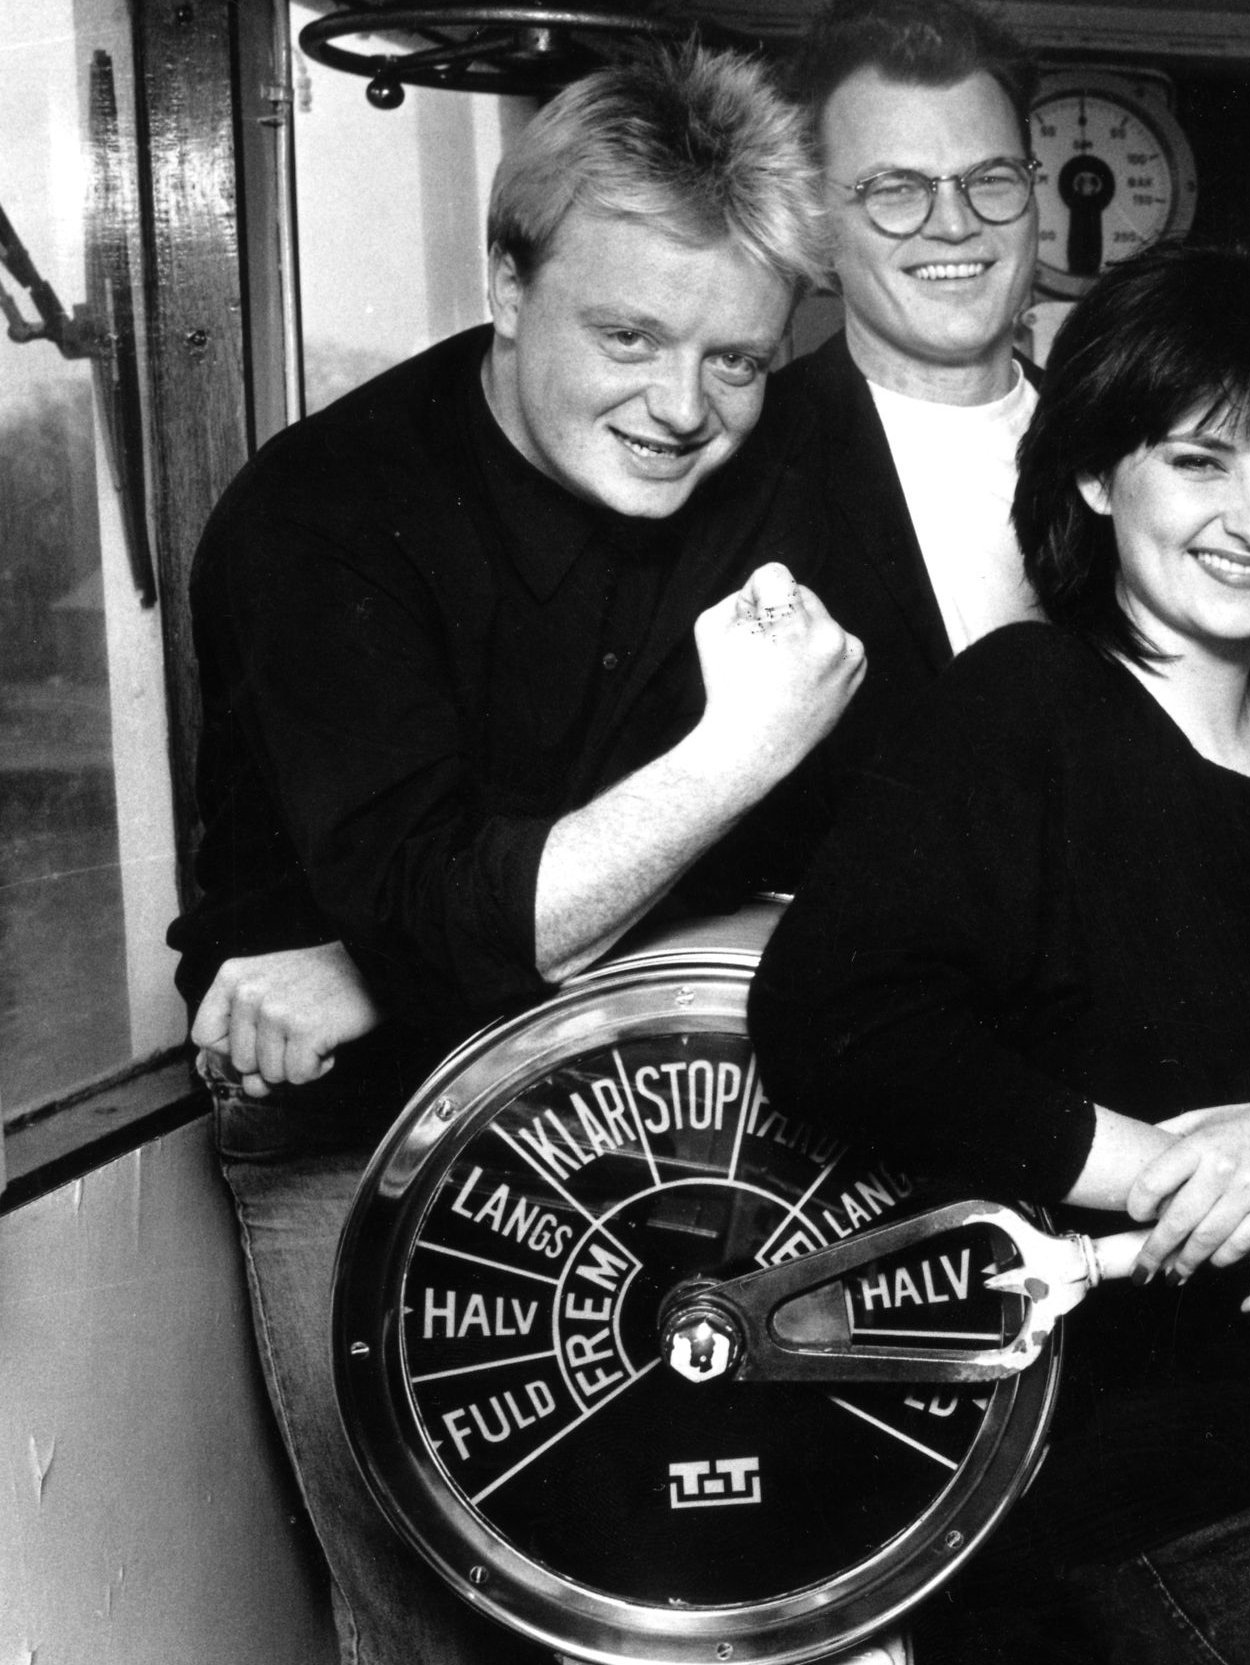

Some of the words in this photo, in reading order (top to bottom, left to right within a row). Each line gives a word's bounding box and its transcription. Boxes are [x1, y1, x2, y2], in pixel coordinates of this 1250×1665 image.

[517, 1078, 638, 1181] KLAR
[634, 1059, 742, 1134] STOP
[451, 1165, 574, 1259] LANGS
[422, 1287, 539, 1340] HALV
[565, 1243, 629, 1397] FREM
[860, 1248, 971, 1311] HALV
[441, 1379, 557, 1462] FULD
